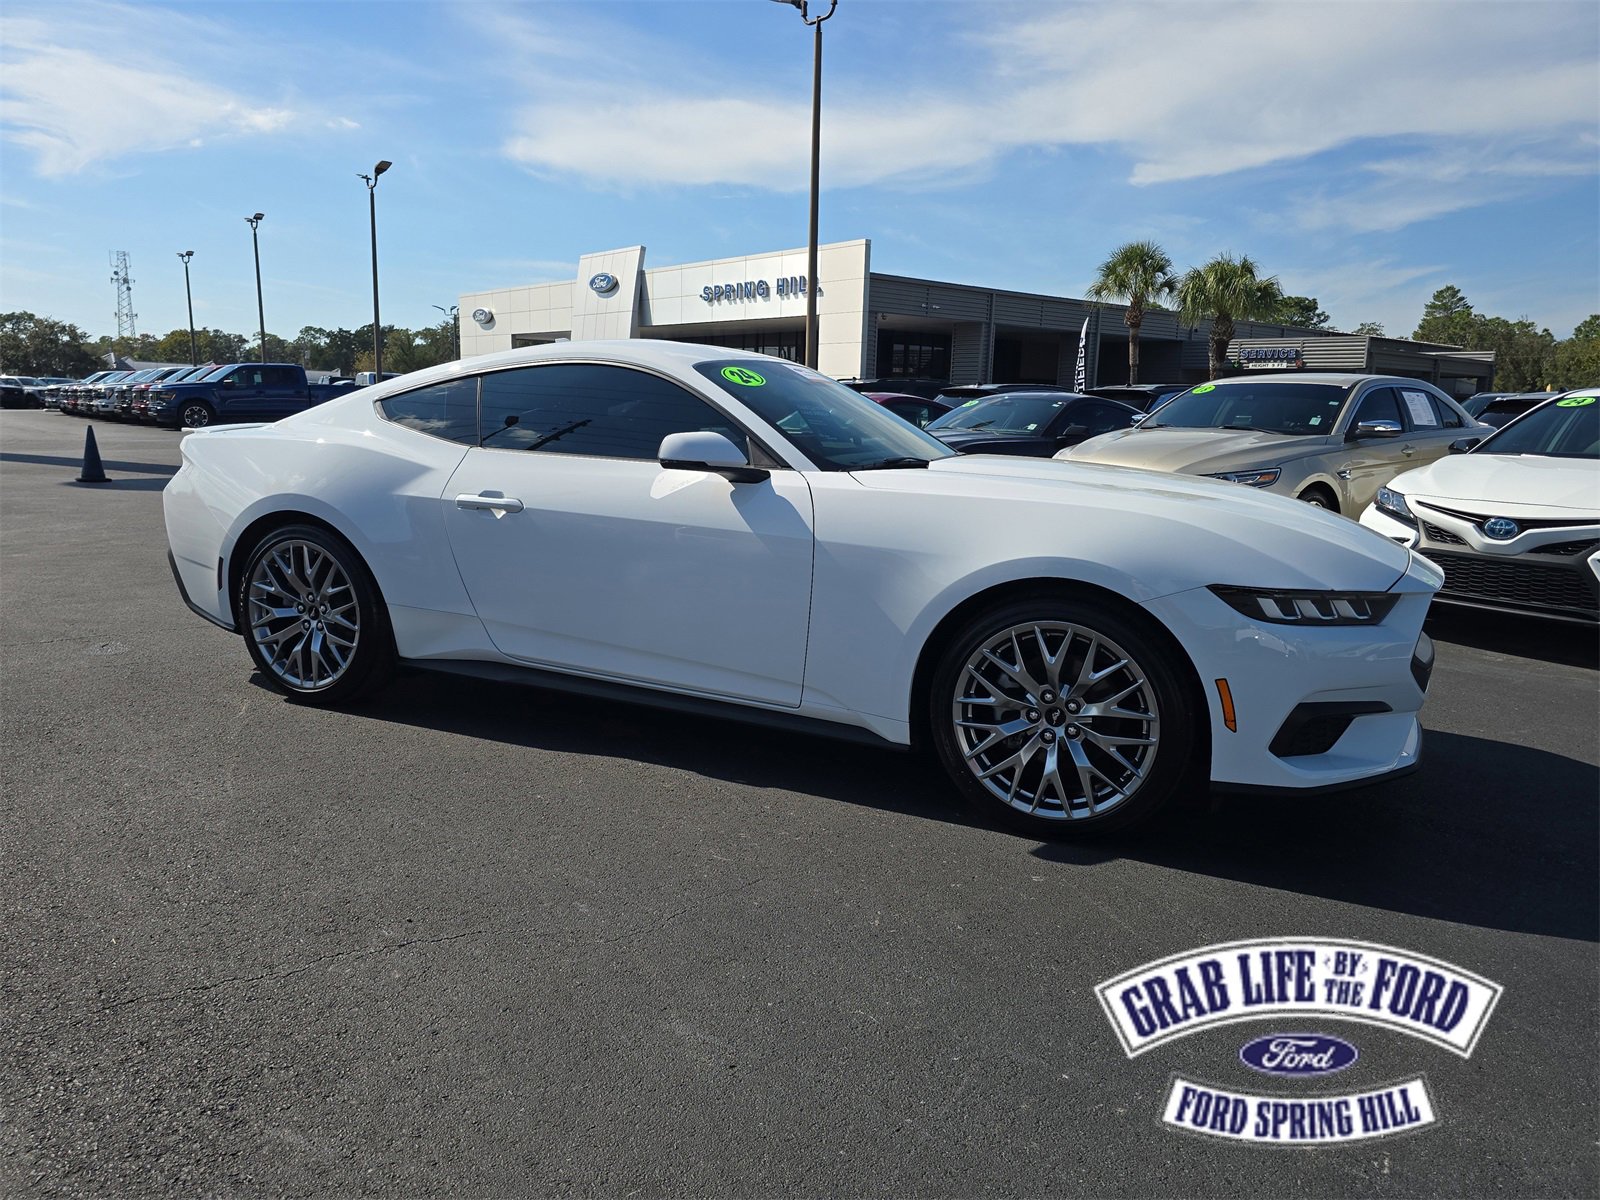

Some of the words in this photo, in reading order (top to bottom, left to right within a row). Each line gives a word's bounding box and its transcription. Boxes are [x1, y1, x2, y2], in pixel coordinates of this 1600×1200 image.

[703, 279, 766, 302] SPRING
[776, 275, 817, 294] HIL
[1240, 348, 1296, 359] SERVICE
[729, 369, 760, 383] 24
